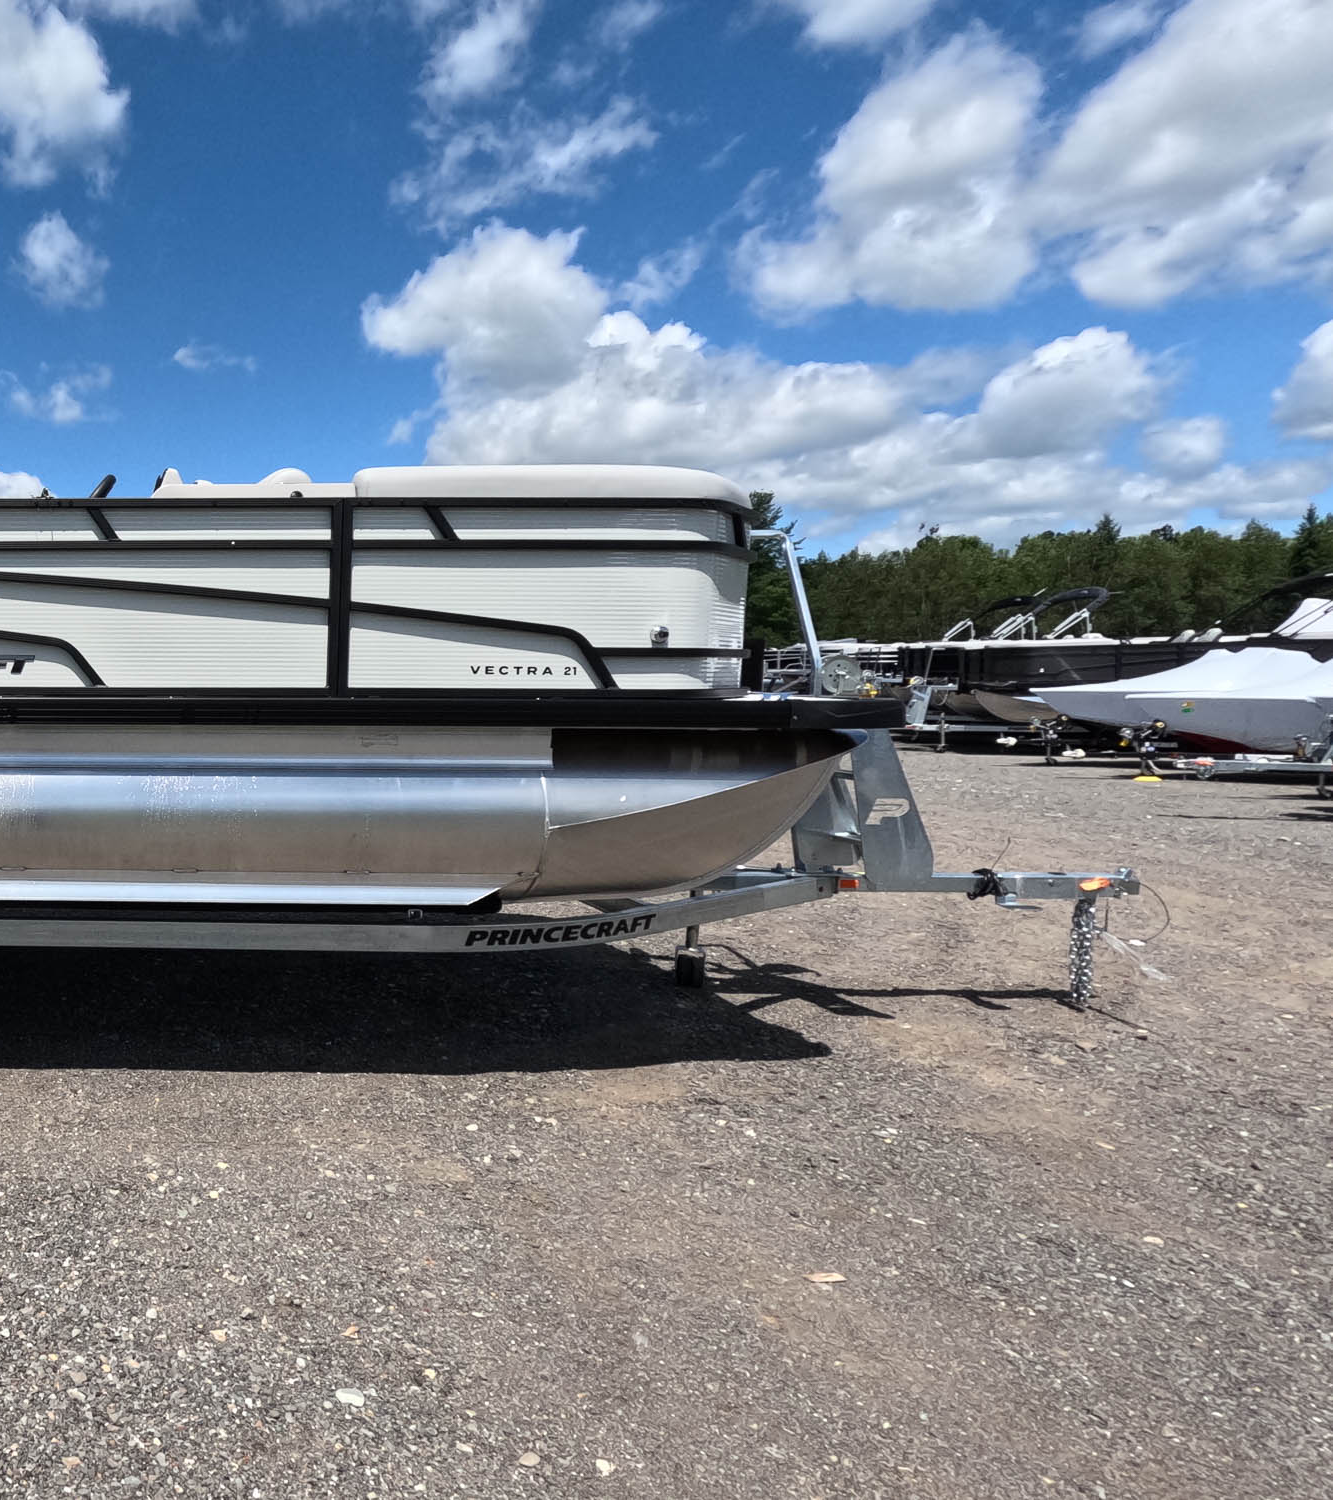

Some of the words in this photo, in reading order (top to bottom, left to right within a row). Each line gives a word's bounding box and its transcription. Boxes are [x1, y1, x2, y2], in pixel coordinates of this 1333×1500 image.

[470, 665, 553, 676] VECTRA
[563, 666, 578, 676] 21
[464, 913, 657, 947] PRINCECRAFT
